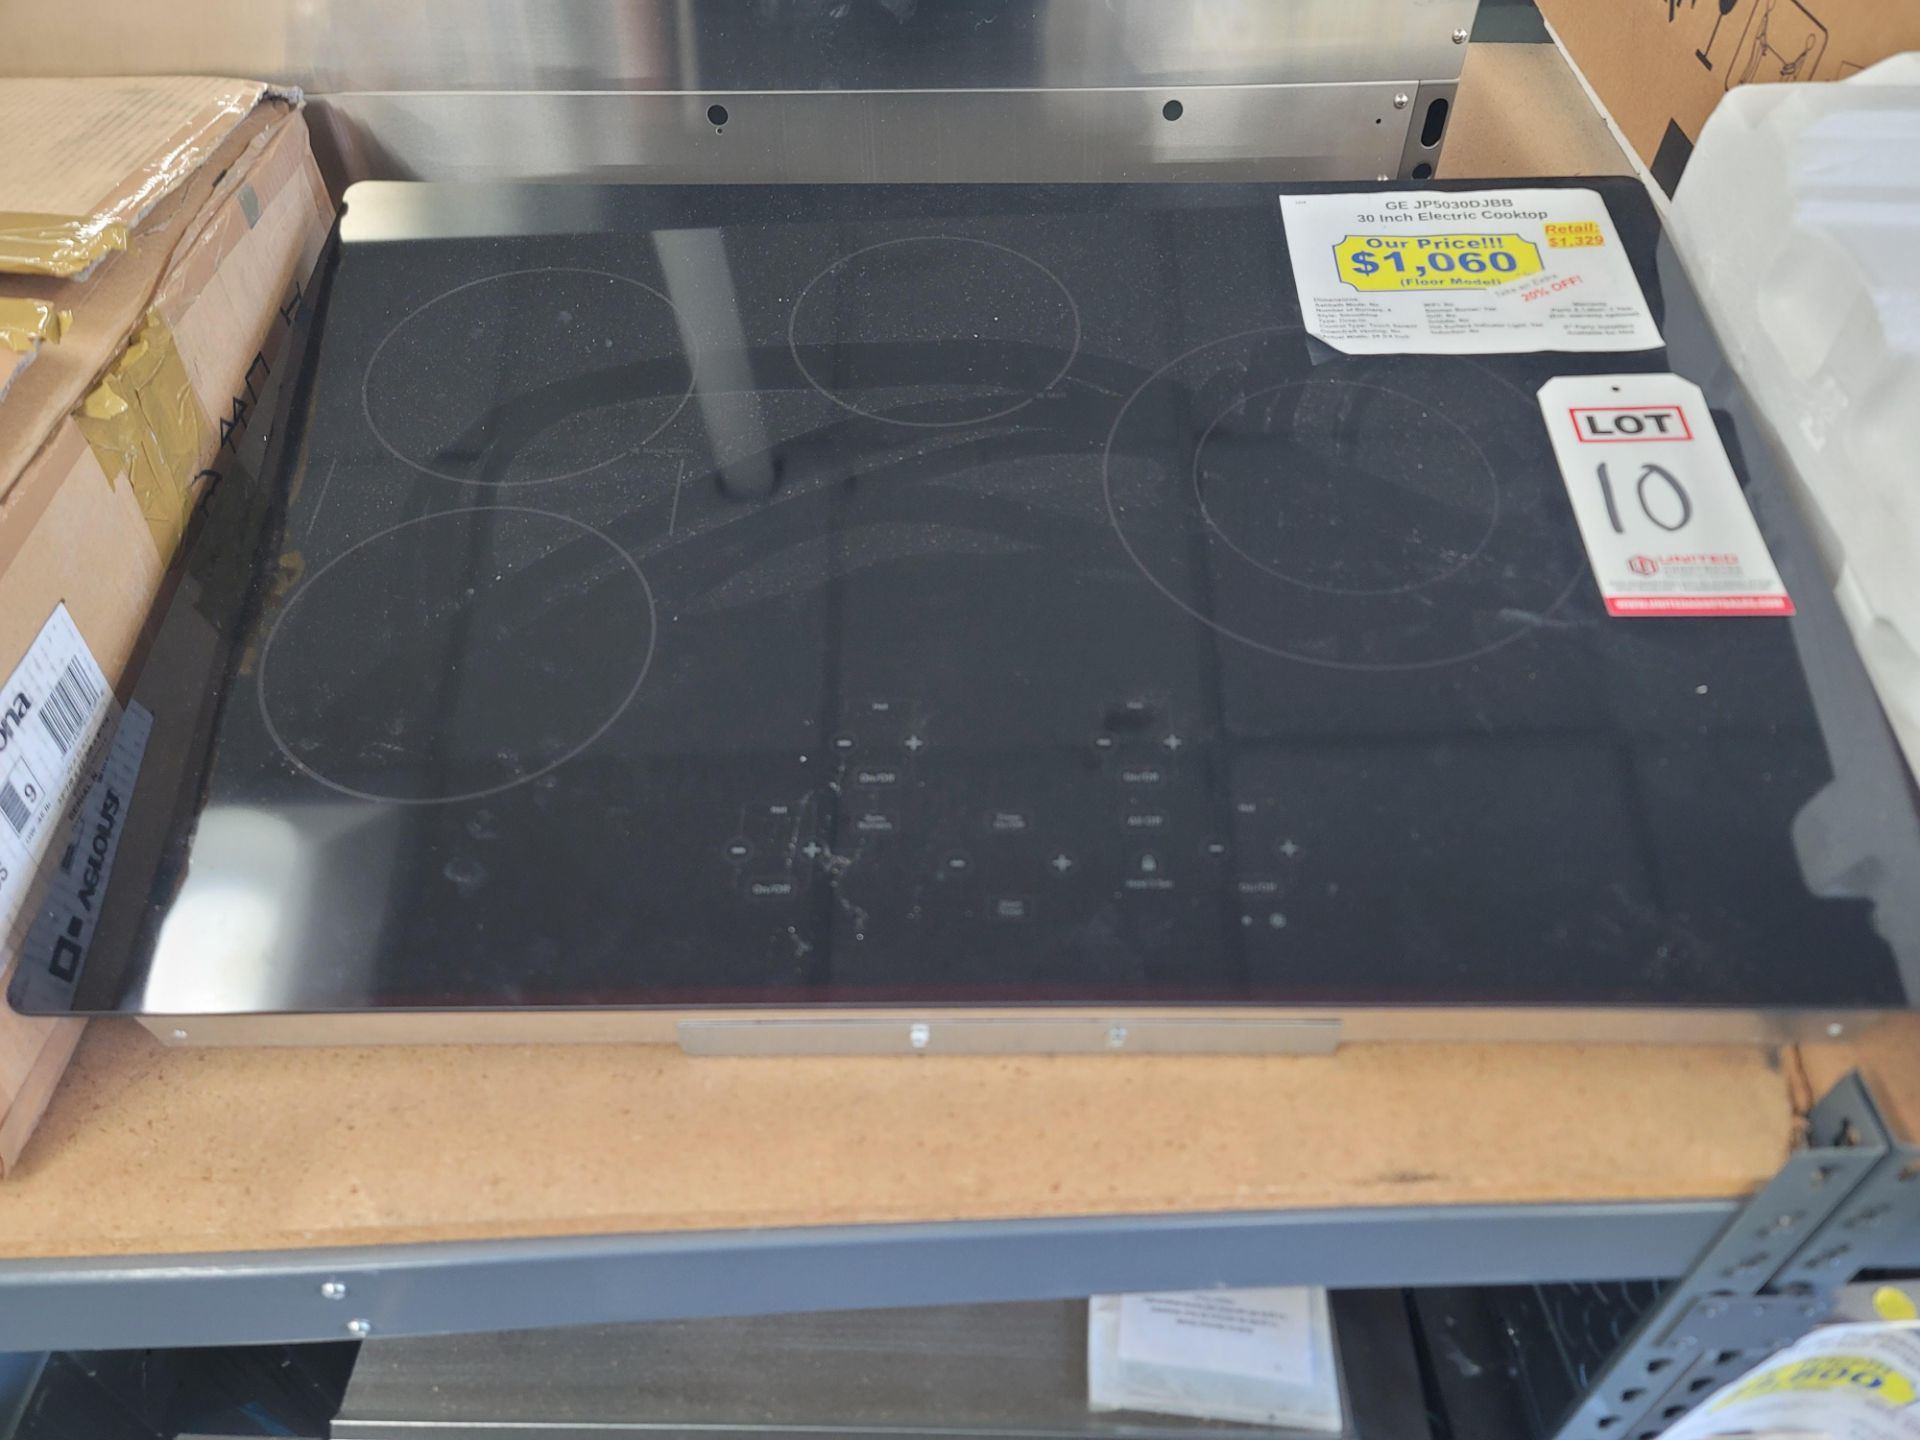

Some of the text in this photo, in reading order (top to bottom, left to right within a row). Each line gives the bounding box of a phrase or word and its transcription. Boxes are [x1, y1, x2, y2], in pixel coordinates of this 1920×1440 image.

[1385, 201, 1408, 210] GE
[1357, 210, 1548, 223] 30 Inch Electric Cooktop
[1545, 223, 1600, 234] Retail:
[1366, 237, 1503, 249] Our Price!!!
[1351, 250, 1517, 277] $1,060
[1400, 278, 1444, 287] (Floor
[1552, 275, 1584, 292] OFF!
[1586, 413, 1672, 435] LOT
[1596, 461, 1693, 534] 10
